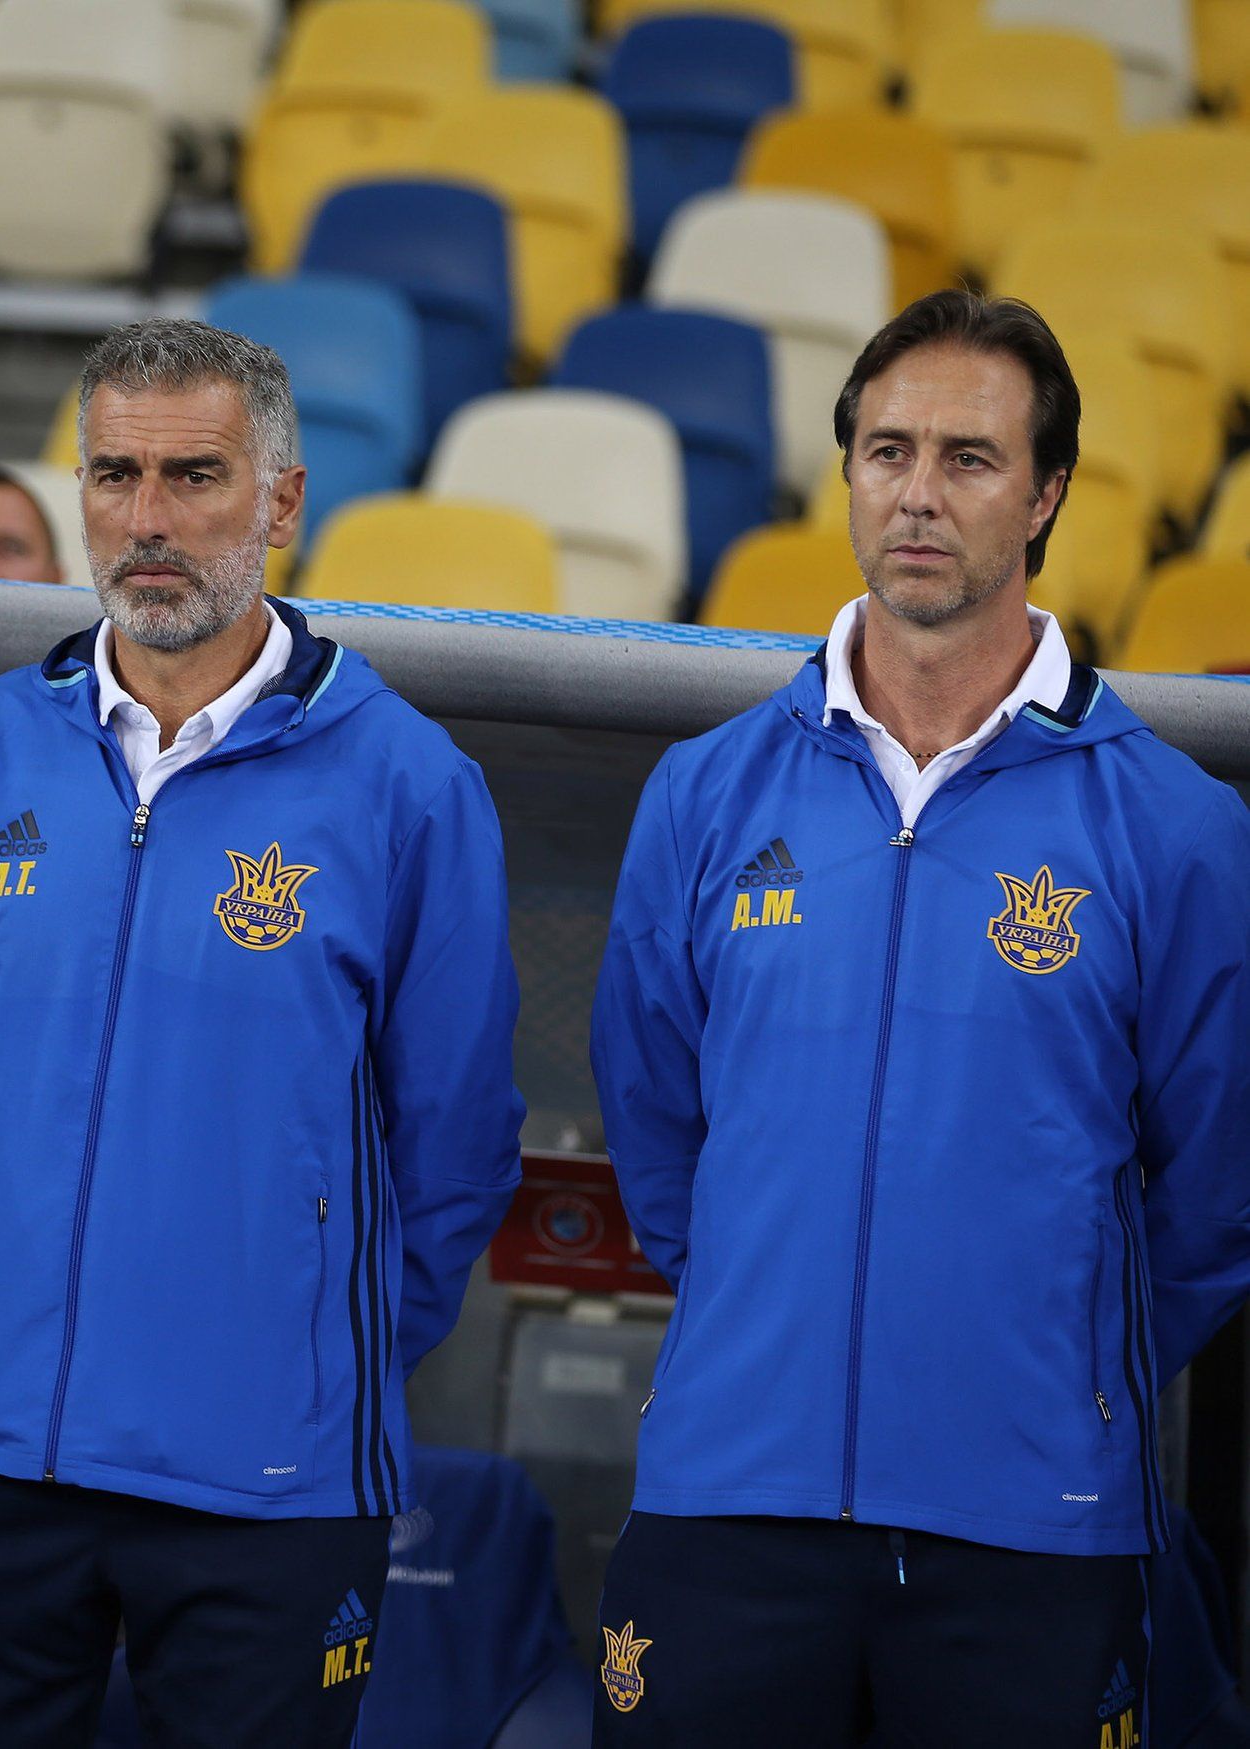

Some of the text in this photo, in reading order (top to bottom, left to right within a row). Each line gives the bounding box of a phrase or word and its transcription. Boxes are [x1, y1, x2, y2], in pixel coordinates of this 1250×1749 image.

[735, 868, 804, 888] adidas
[222, 900, 295, 927] УКРАЇНА
[731, 889, 803, 931] A.M.
[996, 924, 1071, 951] УКРАЇНА
[263, 1465, 297, 1475] climacool
[1062, 1493, 1098, 1502] climacool
[324, 1617, 373, 1646] adidas
[322, 1637, 371, 1688] M.T.
